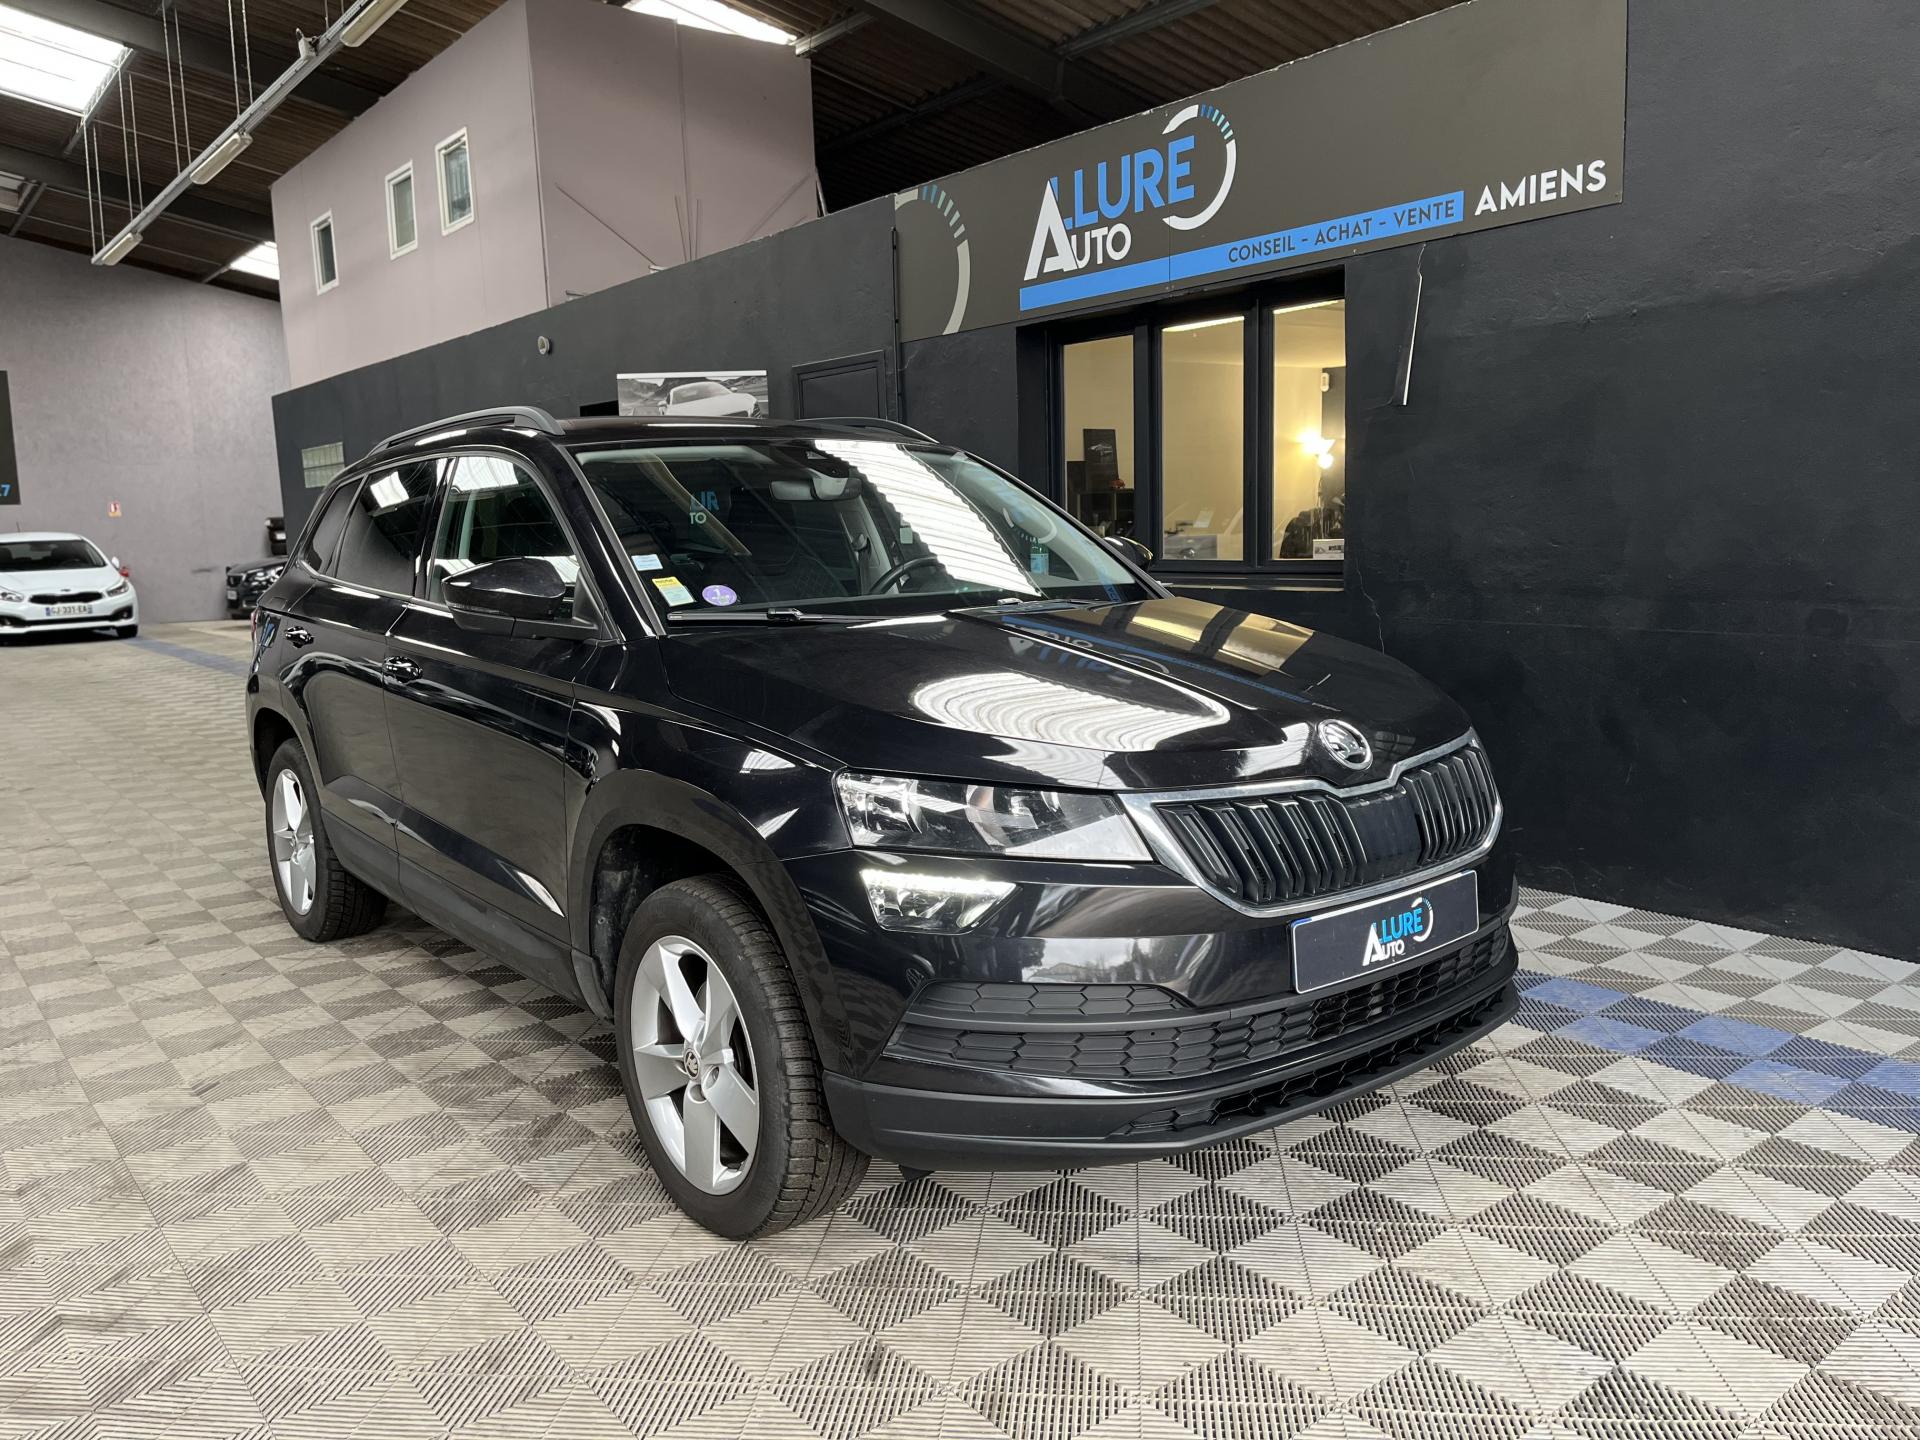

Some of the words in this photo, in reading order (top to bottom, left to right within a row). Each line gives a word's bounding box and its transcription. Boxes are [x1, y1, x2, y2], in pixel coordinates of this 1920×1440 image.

[1024, 180, 1132, 281] AUTO
[1228, 235, 1296, 263] CONSEIL
[1314, 218, 1373, 246] ACHAT
[1394, 199, 1455, 226] VENTE
[1474, 159, 1607, 216] AMIENS
[0, 484, 10, 496] 7
[1362, 924, 1405, 967] AUTO
